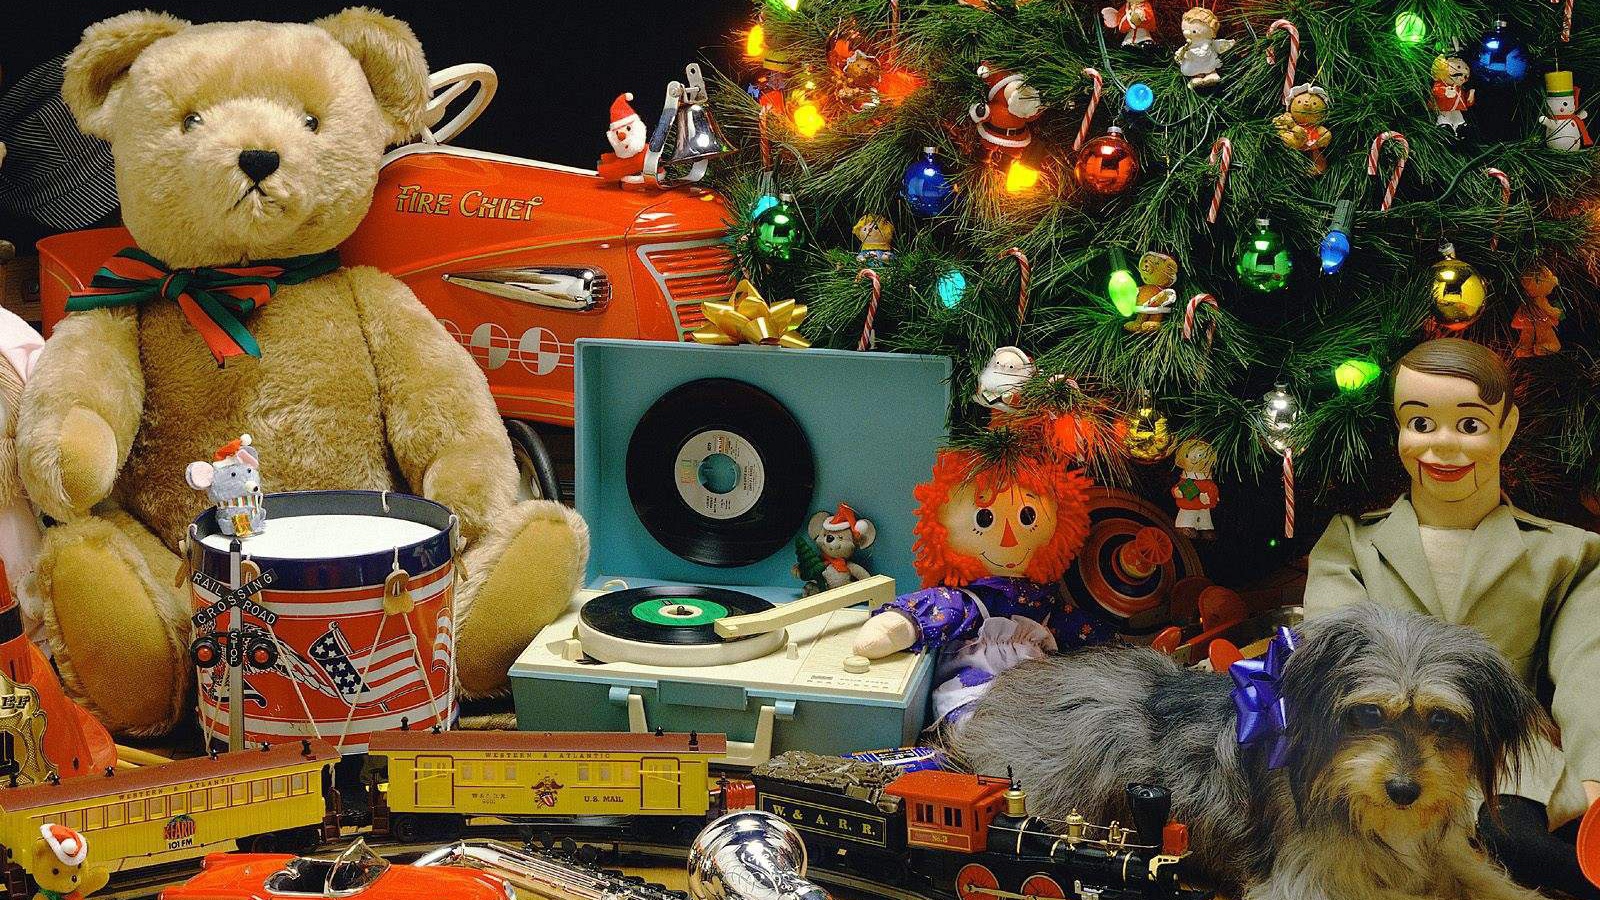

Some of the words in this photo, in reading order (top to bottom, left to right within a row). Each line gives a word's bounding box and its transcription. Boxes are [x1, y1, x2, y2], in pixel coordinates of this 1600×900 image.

[396, 184, 453, 215] FIRE
[459, 190, 544, 221] CHIEF
[193, 572, 223, 596] RAIL
[242, 600, 276, 625] ROAD
[197, 573, 273, 624] CROSSING
[230, 632, 238, 665] STOP
[118, 788, 163, 801] WESTERN
[188, 776, 236, 790] ATLANTIC
[772, 804, 786, 817] W.
[792, 808, 803, 820] &
[815, 813, 828, 826] A.
[838, 818, 852, 830] R.
[862, 823, 875, 835] R.
[168, 840, 180, 850] 101
[181, 838, 193, 848] FM
